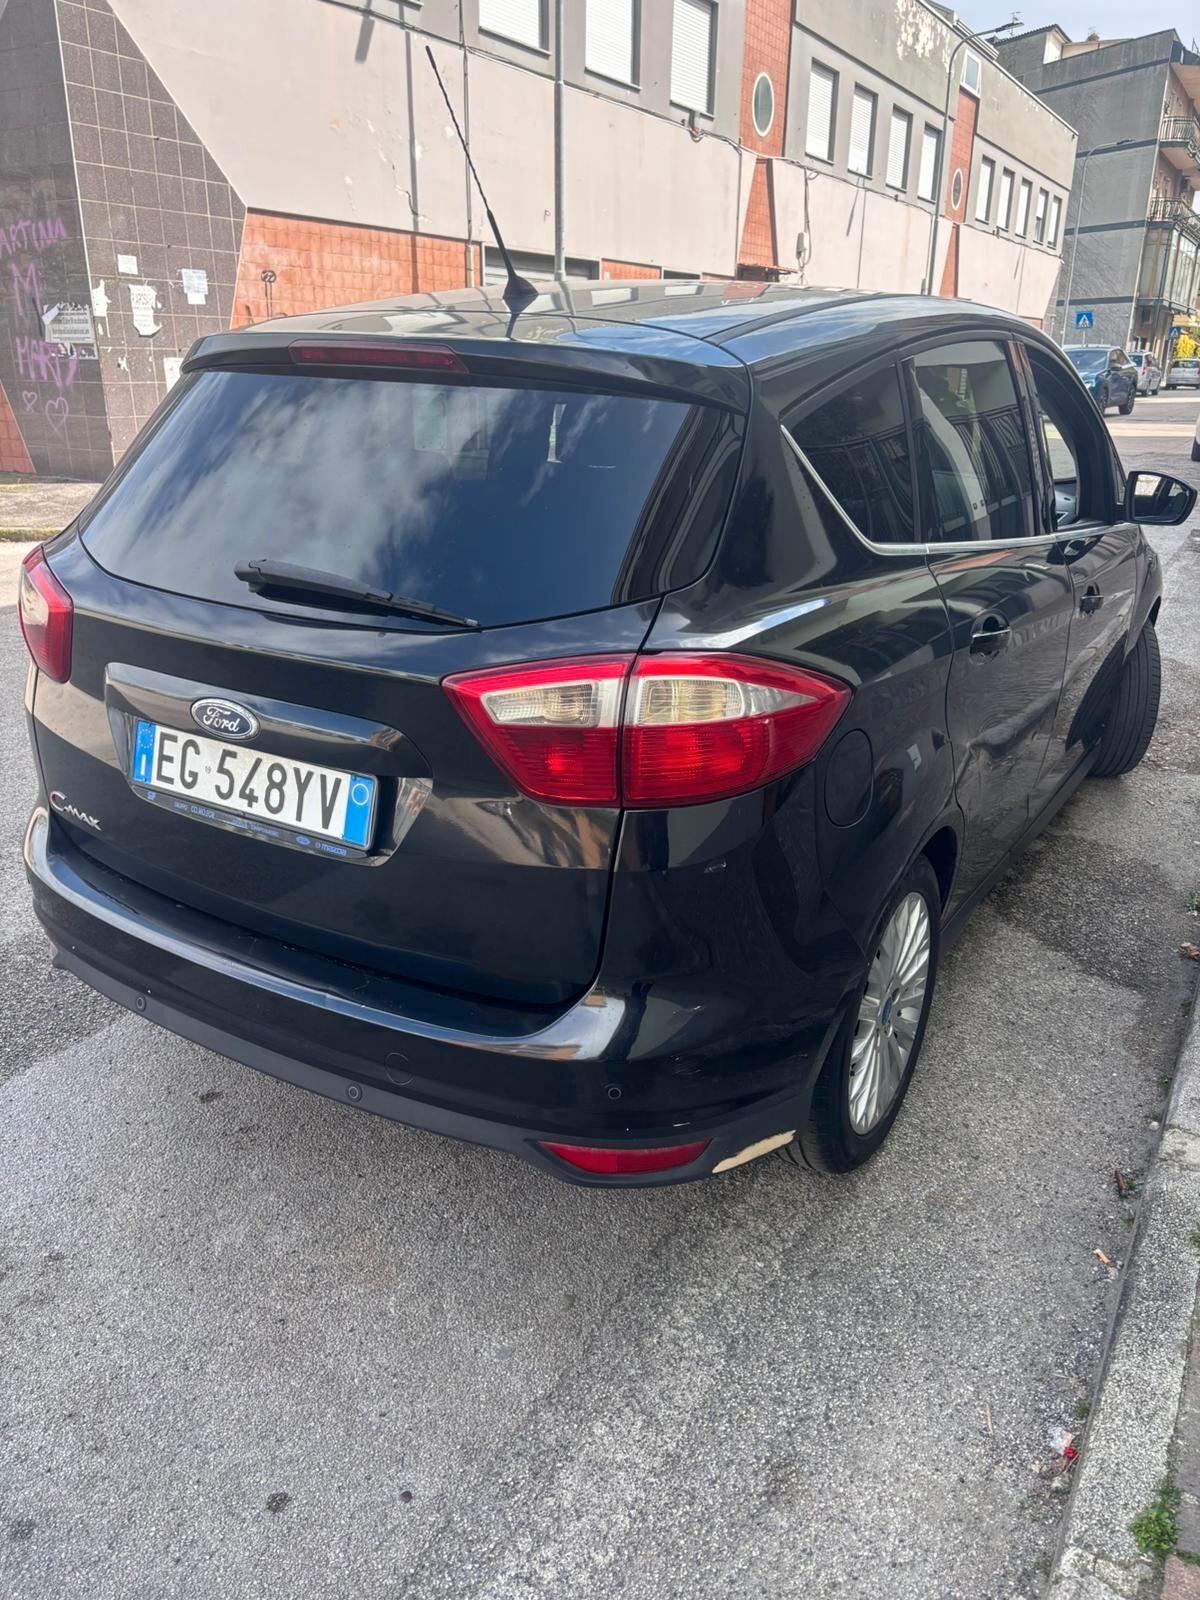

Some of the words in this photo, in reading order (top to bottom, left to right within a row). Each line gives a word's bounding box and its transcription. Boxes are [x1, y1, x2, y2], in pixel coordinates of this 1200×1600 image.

[11, 262, 43, 316] M
[202, 706, 240, 733] Ford
[156, 731, 201, 790] EG
[214, 748, 342, 830] 548YV
